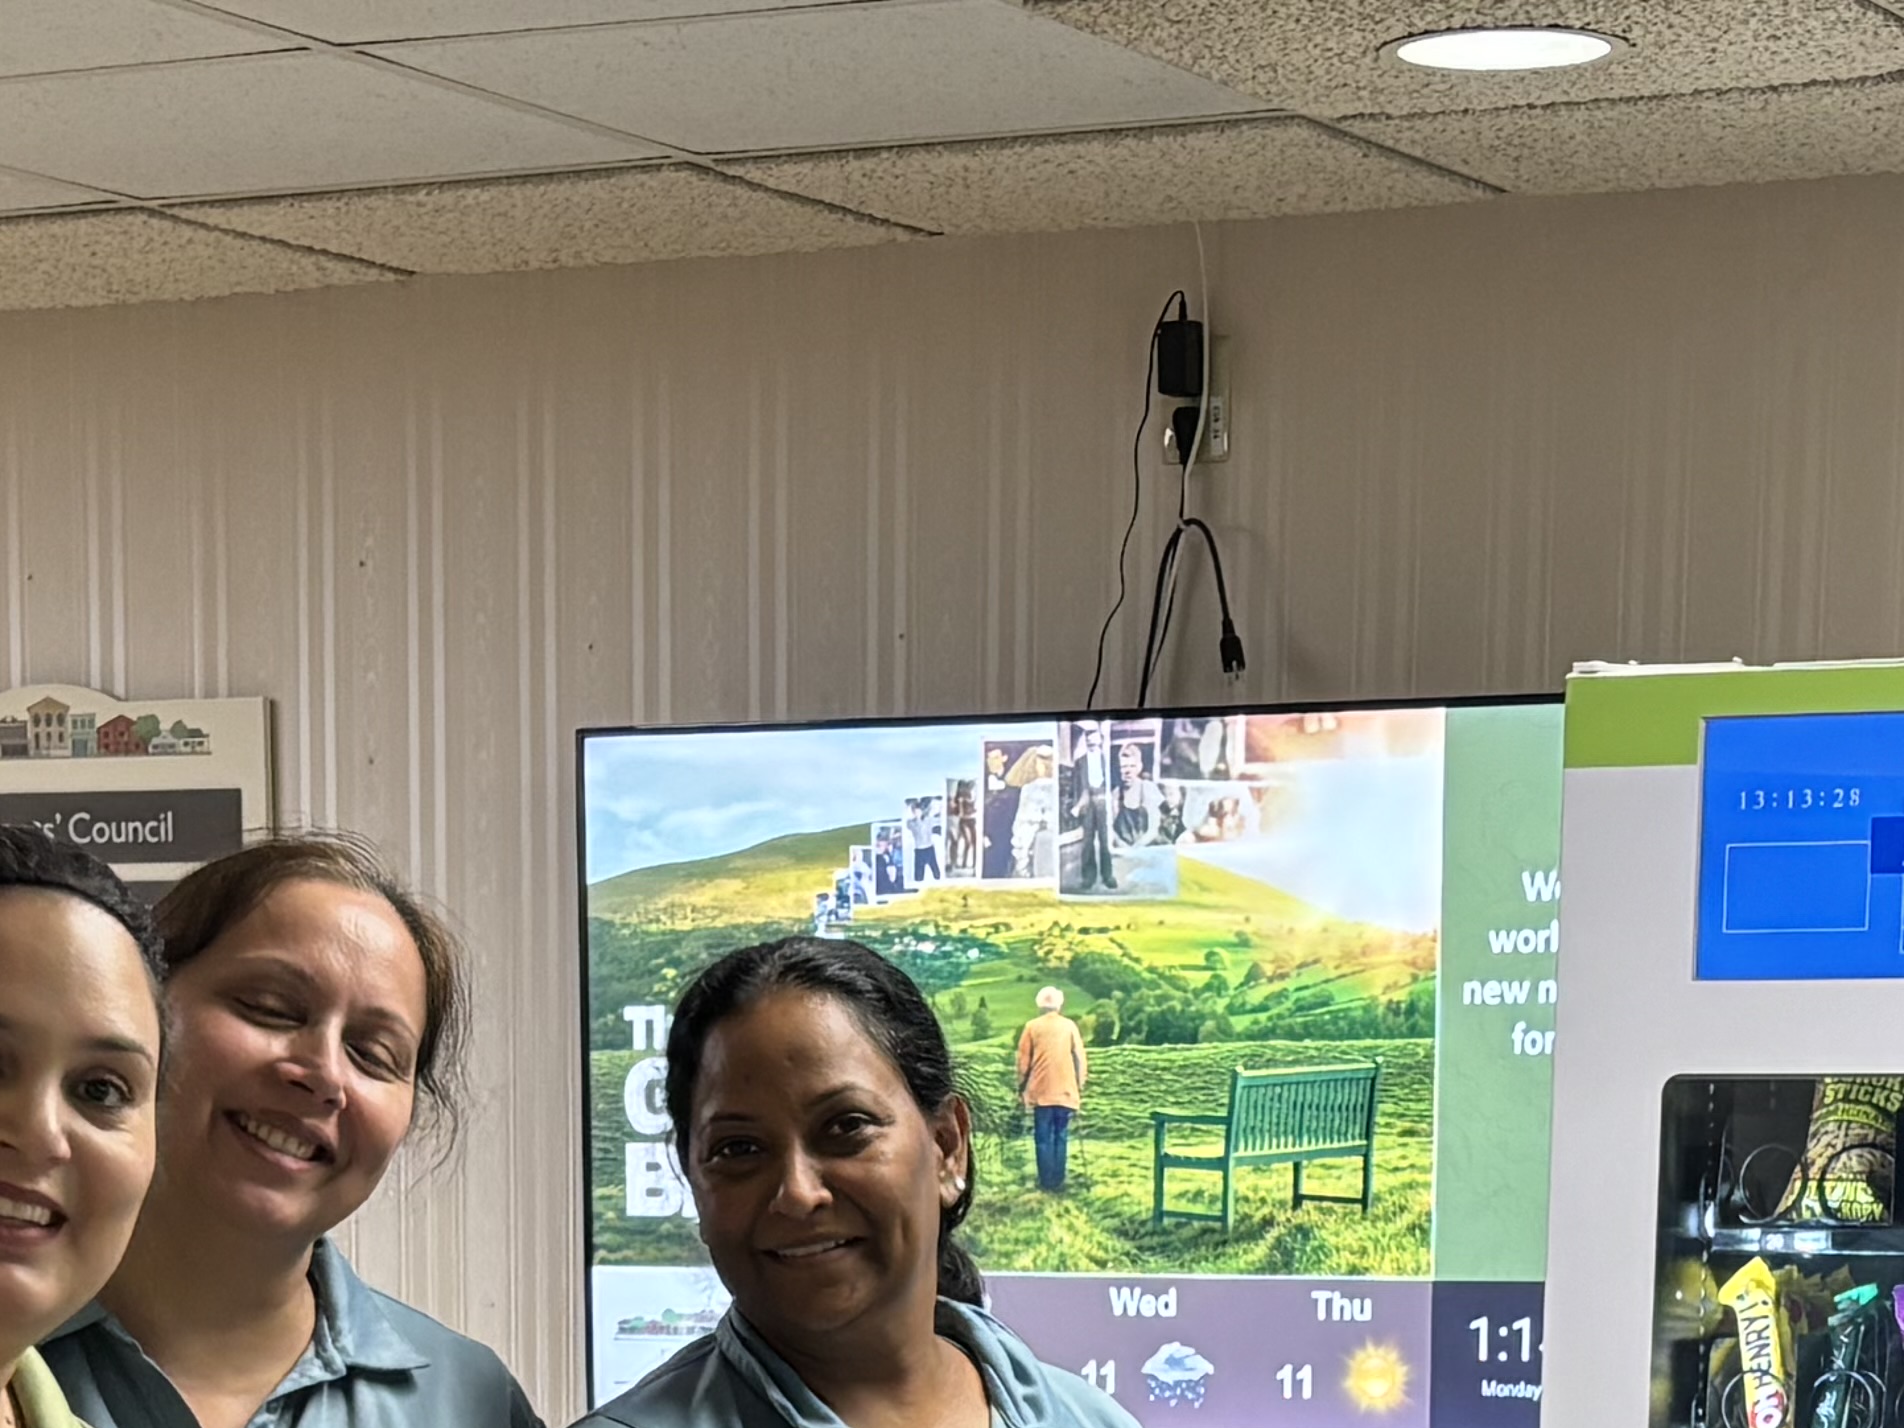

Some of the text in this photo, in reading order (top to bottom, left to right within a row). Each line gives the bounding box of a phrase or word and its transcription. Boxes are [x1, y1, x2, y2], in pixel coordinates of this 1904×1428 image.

[1739, 787, 1862, 811] 13:13:28
[68, 811, 174, 844] Council
[1462, 979, 1531, 1006] new
[1823, 1083, 1904, 1113] STICKS
[1109, 1286, 1178, 1317] Wed
[1310, 1290, 1373, 1322] Thu
[1469, 1316, 1544, 1362] 1:1
[1080, 1359, 1116, 1394] 11
[1275, 1364, 1314, 1400] 11
[1480, 1379, 1543, 1403] Monday
